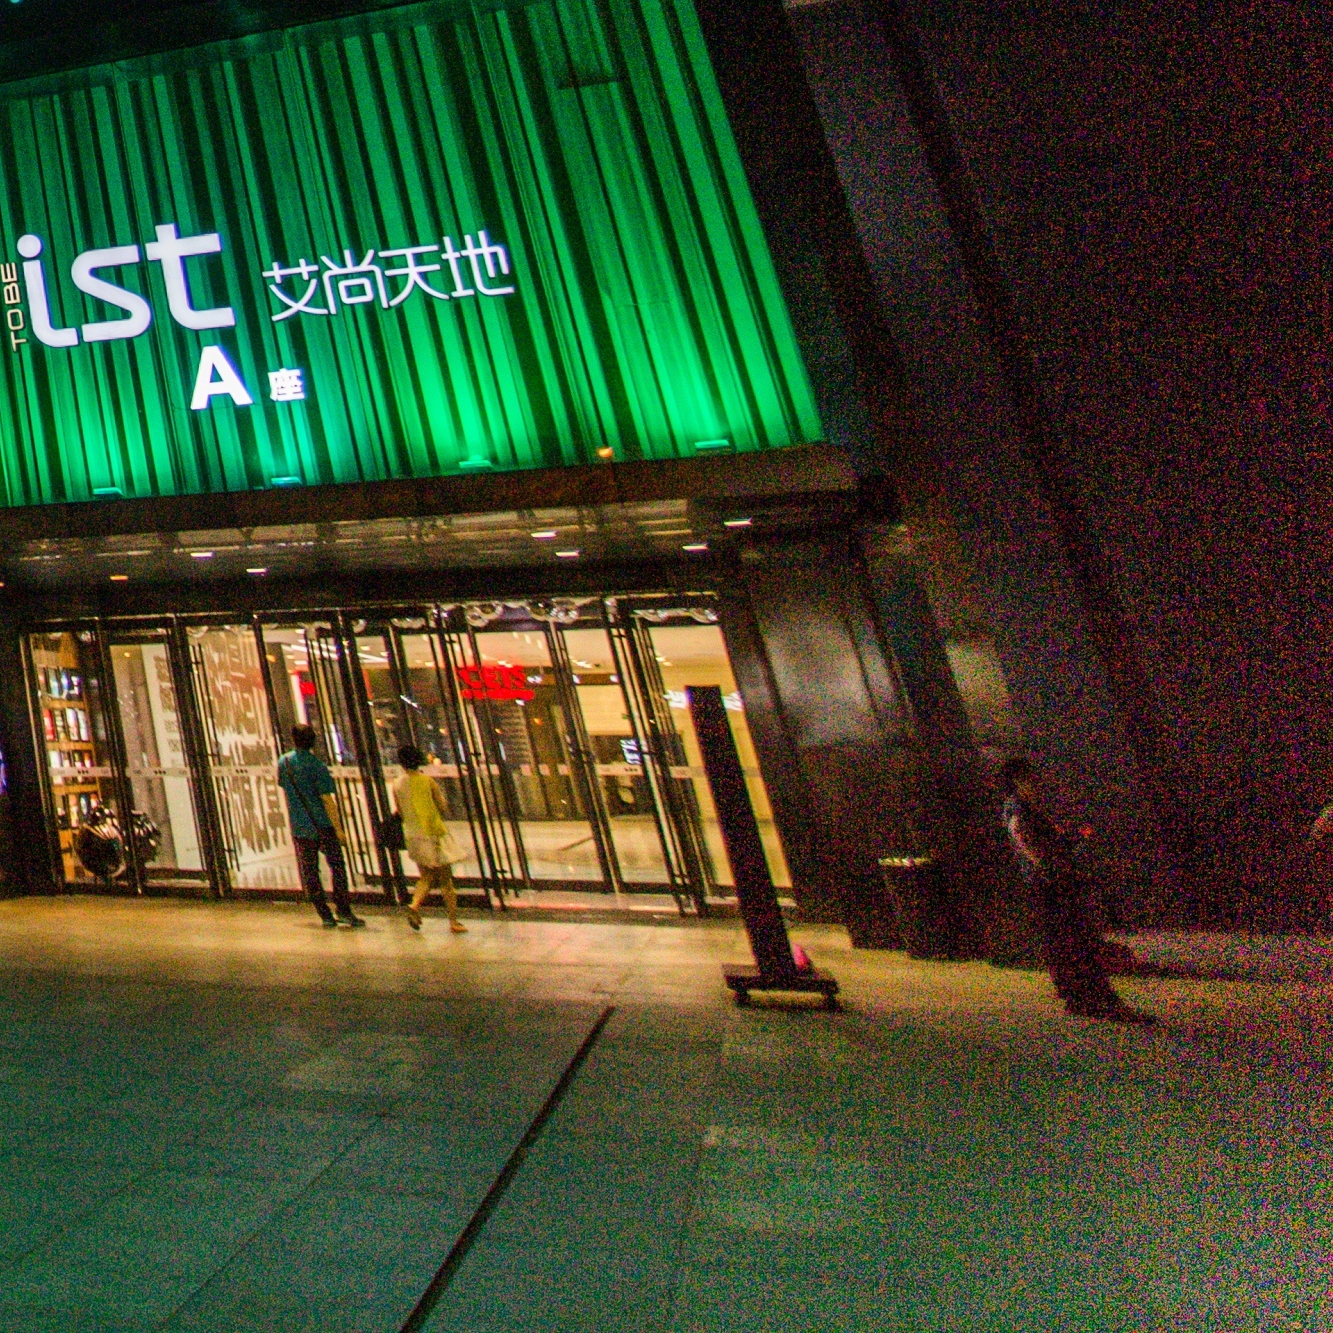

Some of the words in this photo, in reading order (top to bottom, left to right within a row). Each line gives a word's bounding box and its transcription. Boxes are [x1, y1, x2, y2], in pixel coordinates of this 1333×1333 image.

[262, 230, 515, 322] 艾尚天地
[190, 344, 255, 411] A
[267, 367, 306, 401] 座
